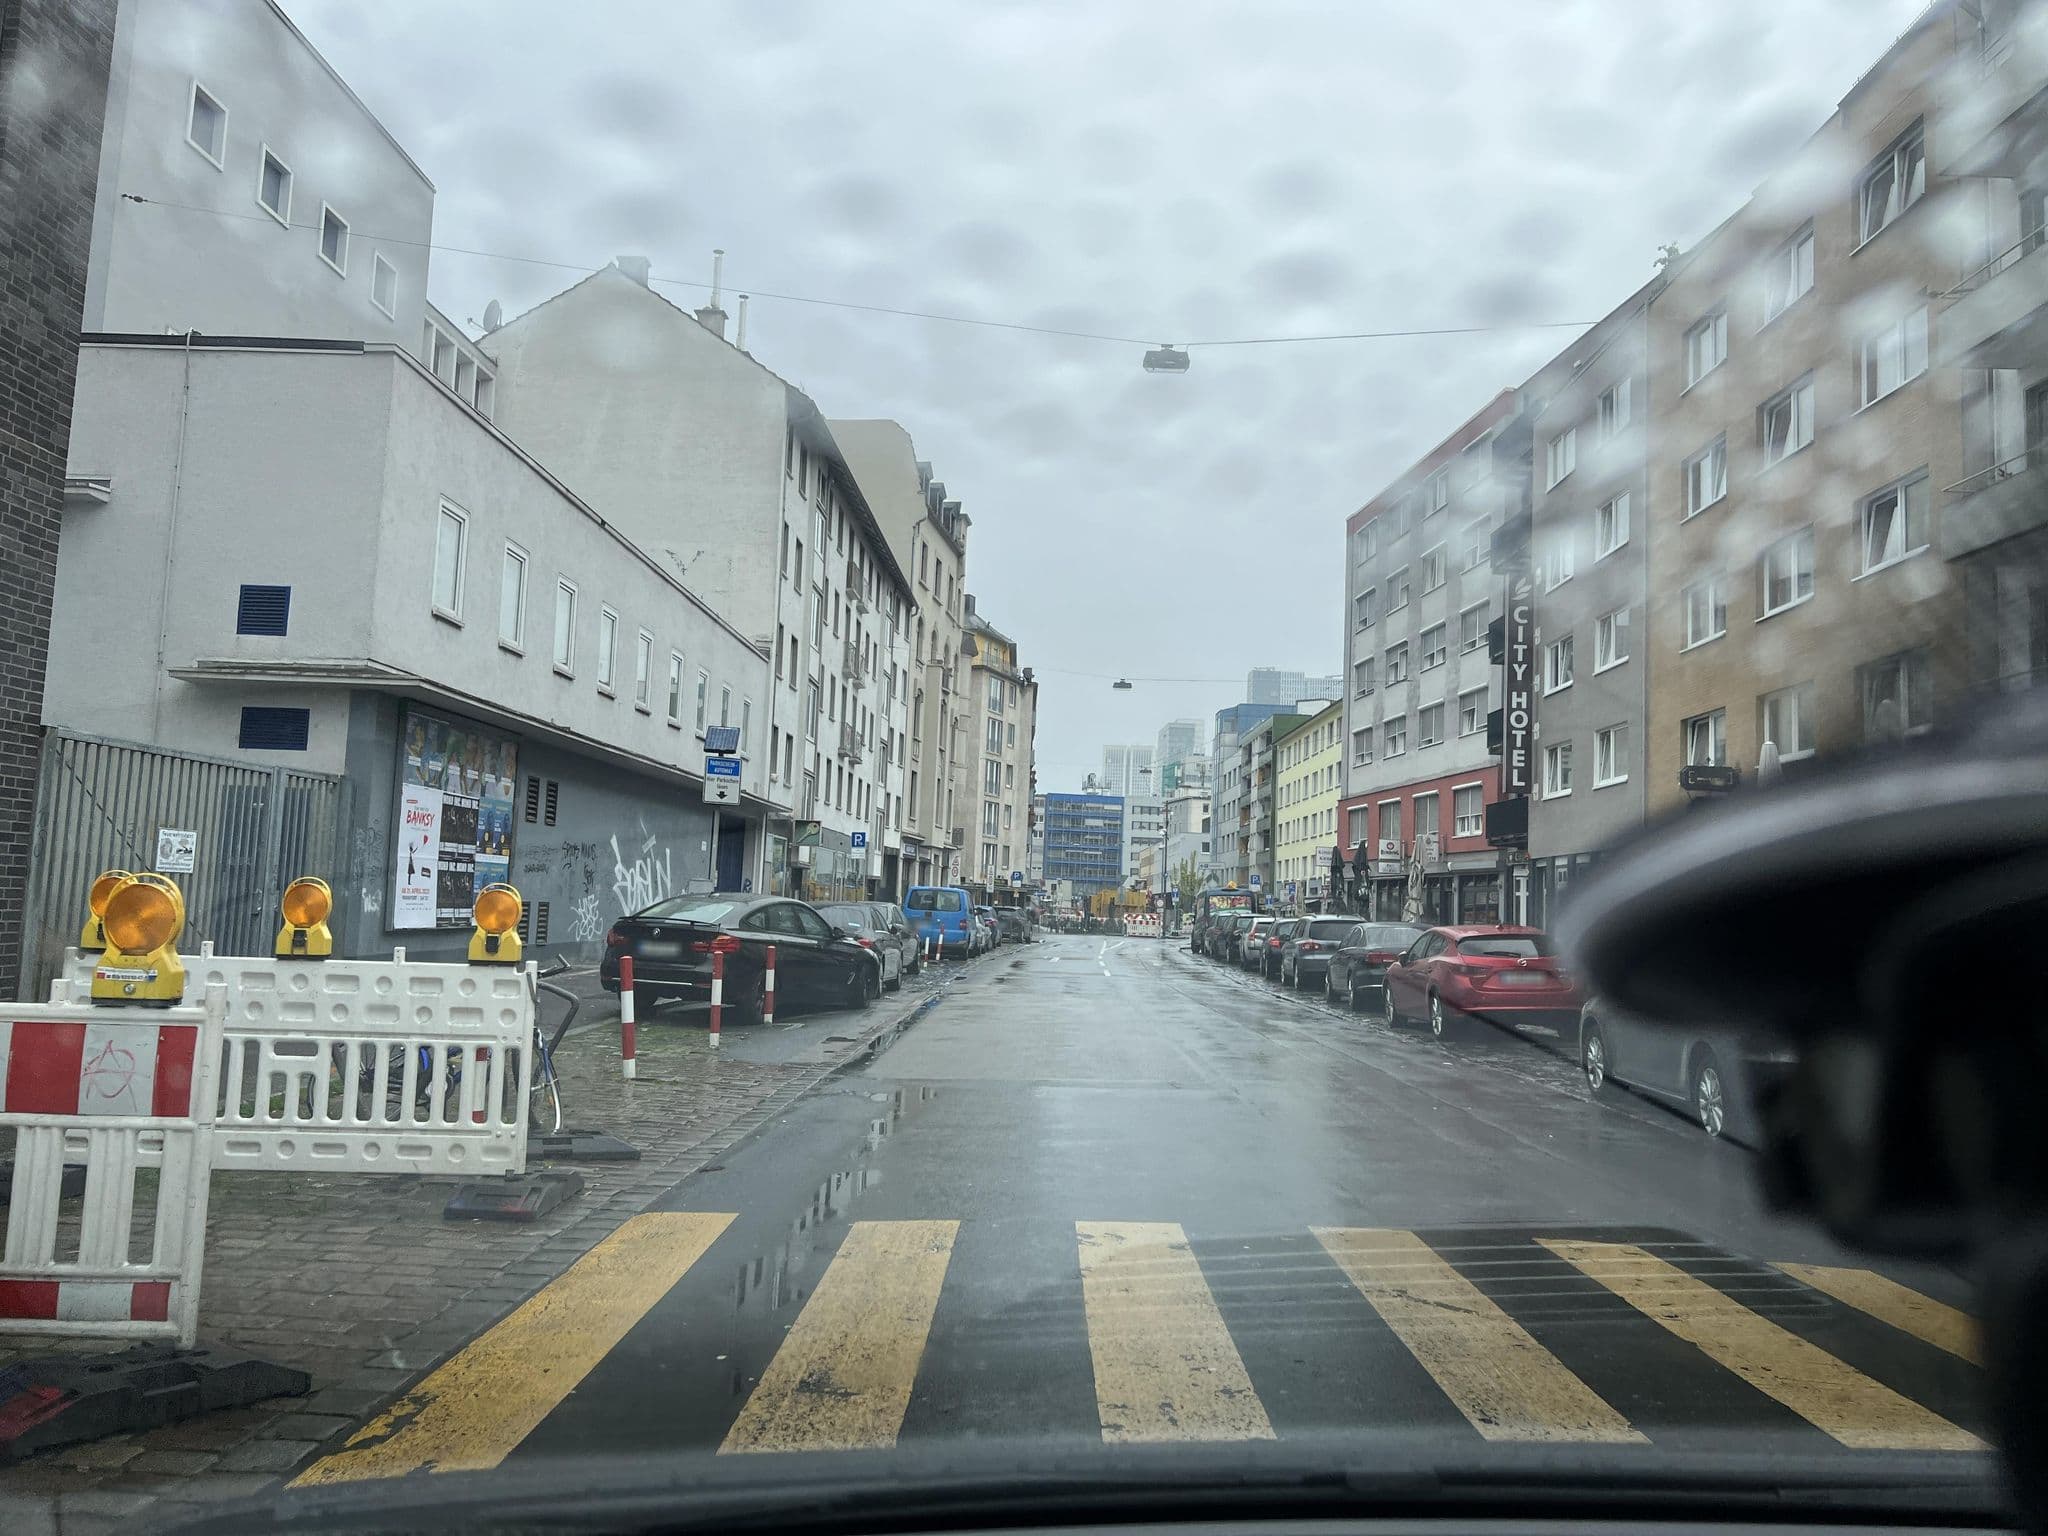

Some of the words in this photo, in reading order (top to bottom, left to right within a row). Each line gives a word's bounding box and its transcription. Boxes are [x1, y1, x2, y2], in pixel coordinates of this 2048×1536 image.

[1512, 605, 1529, 681] CITY
[1509, 691, 1529, 787] HOTEL
[406, 810, 436, 828] BANKSY
